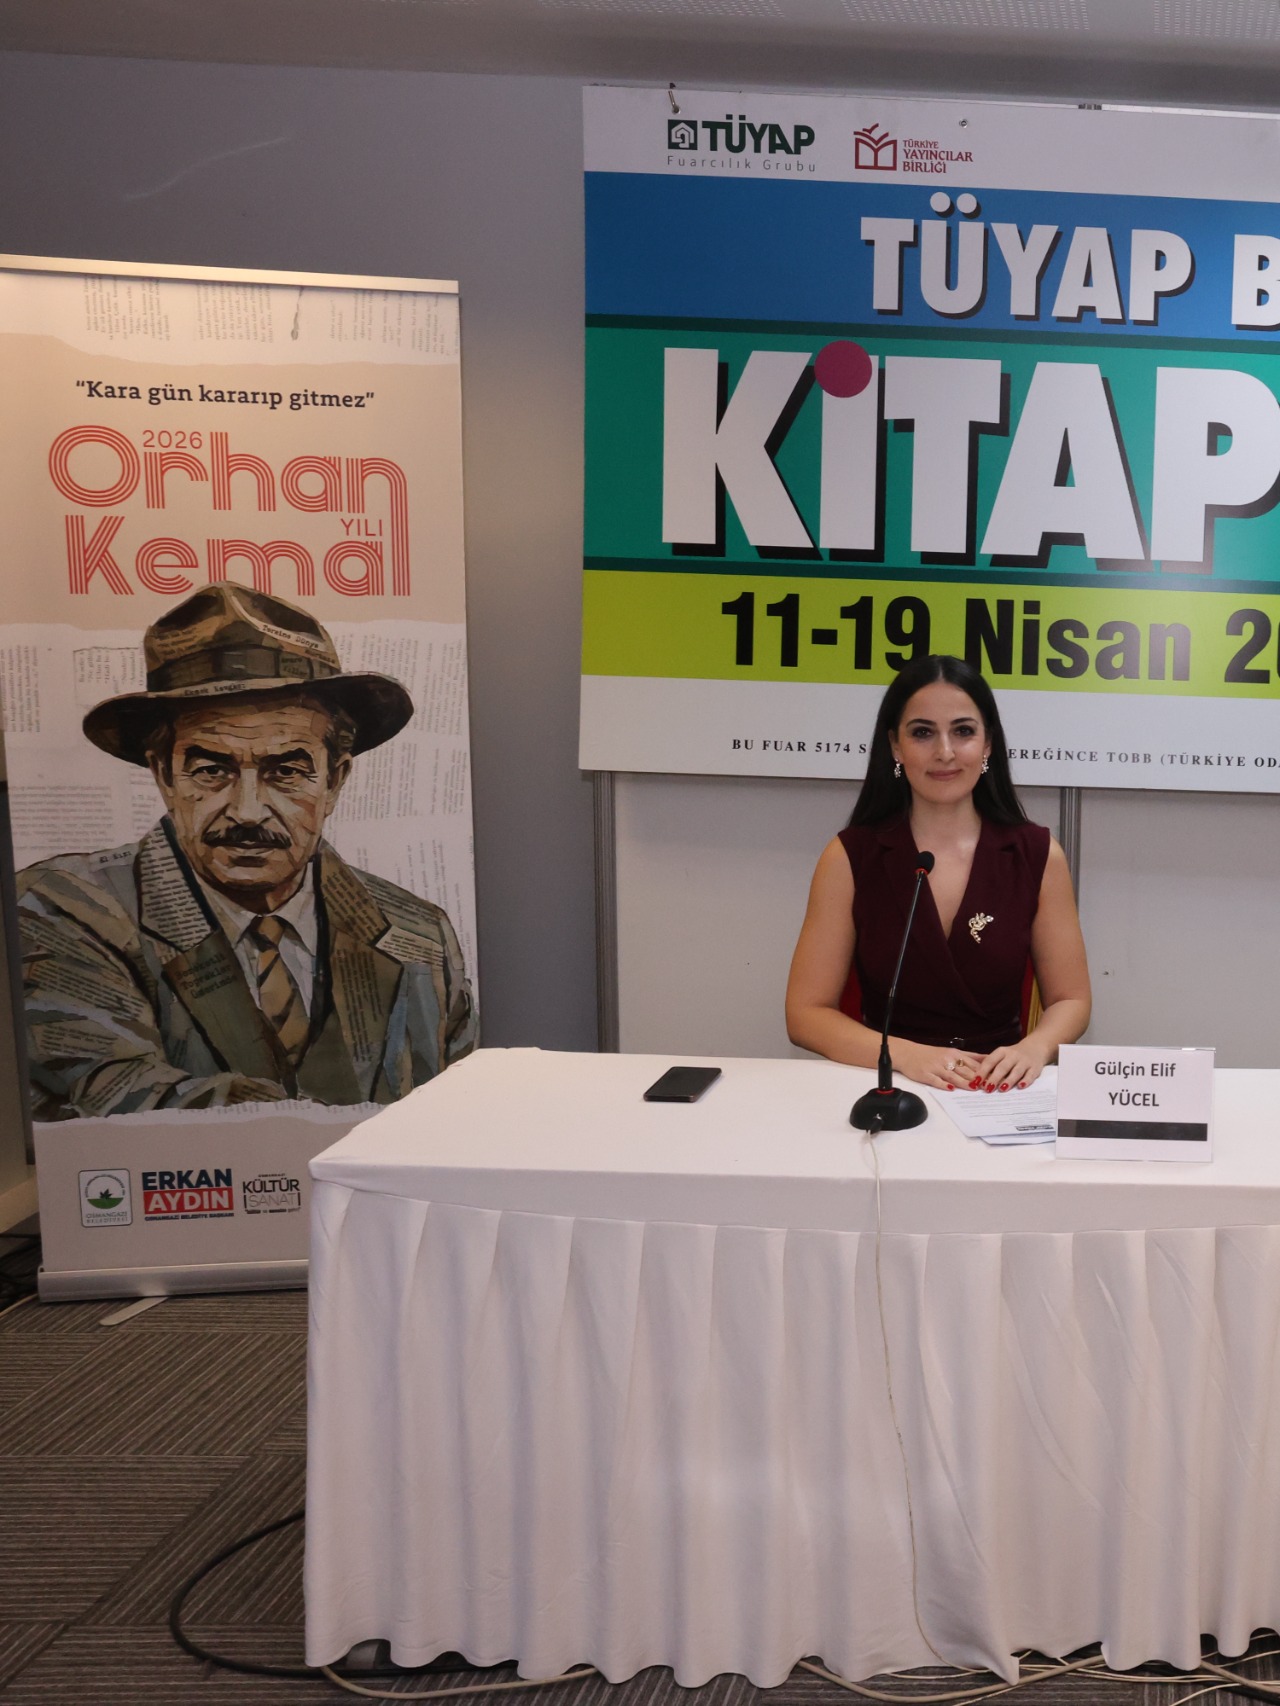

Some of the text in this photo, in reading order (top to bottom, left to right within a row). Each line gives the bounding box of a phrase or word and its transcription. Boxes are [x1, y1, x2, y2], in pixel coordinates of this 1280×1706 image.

[702, 114, 815, 155] TÜYAP
[903, 139, 939, 149] TÜRKİYE
[667, 156, 816, 172] Fuarcılık Grubu
[903, 149, 973, 162] YAYINCILAR
[903, 160, 946, 174] BİRLİĞİ
[861, 191, 1193, 324] TÜYAP
[76, 380, 376, 411] “Kara gün kararıp gitmez”
[142, 429, 203, 449] 2026
[49, 425, 410, 514] Orhan
[340, 518, 384, 537] YILI
[65, 514, 411, 597] Kemal
[721, 592, 930, 671] 11-19
[964, 598, 1192, 681] Nisan
[732, 739, 754, 750] BU
[762, 740, 807, 752] FUAR
[815, 742, 850, 753] 5174
[1007, 747, 1098, 762] EREĞİNCE
[1107, 751, 1152, 764] TOBB
[1160, 751, 1246, 767] (TÜRKİYE
[1095, 1061, 1176, 1079] Gülçin Elif
[1109, 1089, 1159, 1108] YÜCEL
[142, 1169, 232, 1191] ERKAN
[243, 1178, 300, 1193] KÜLTÜR
[149, 1190, 229, 1212] AYDIN
[248, 1193, 296, 1207] SANAT
